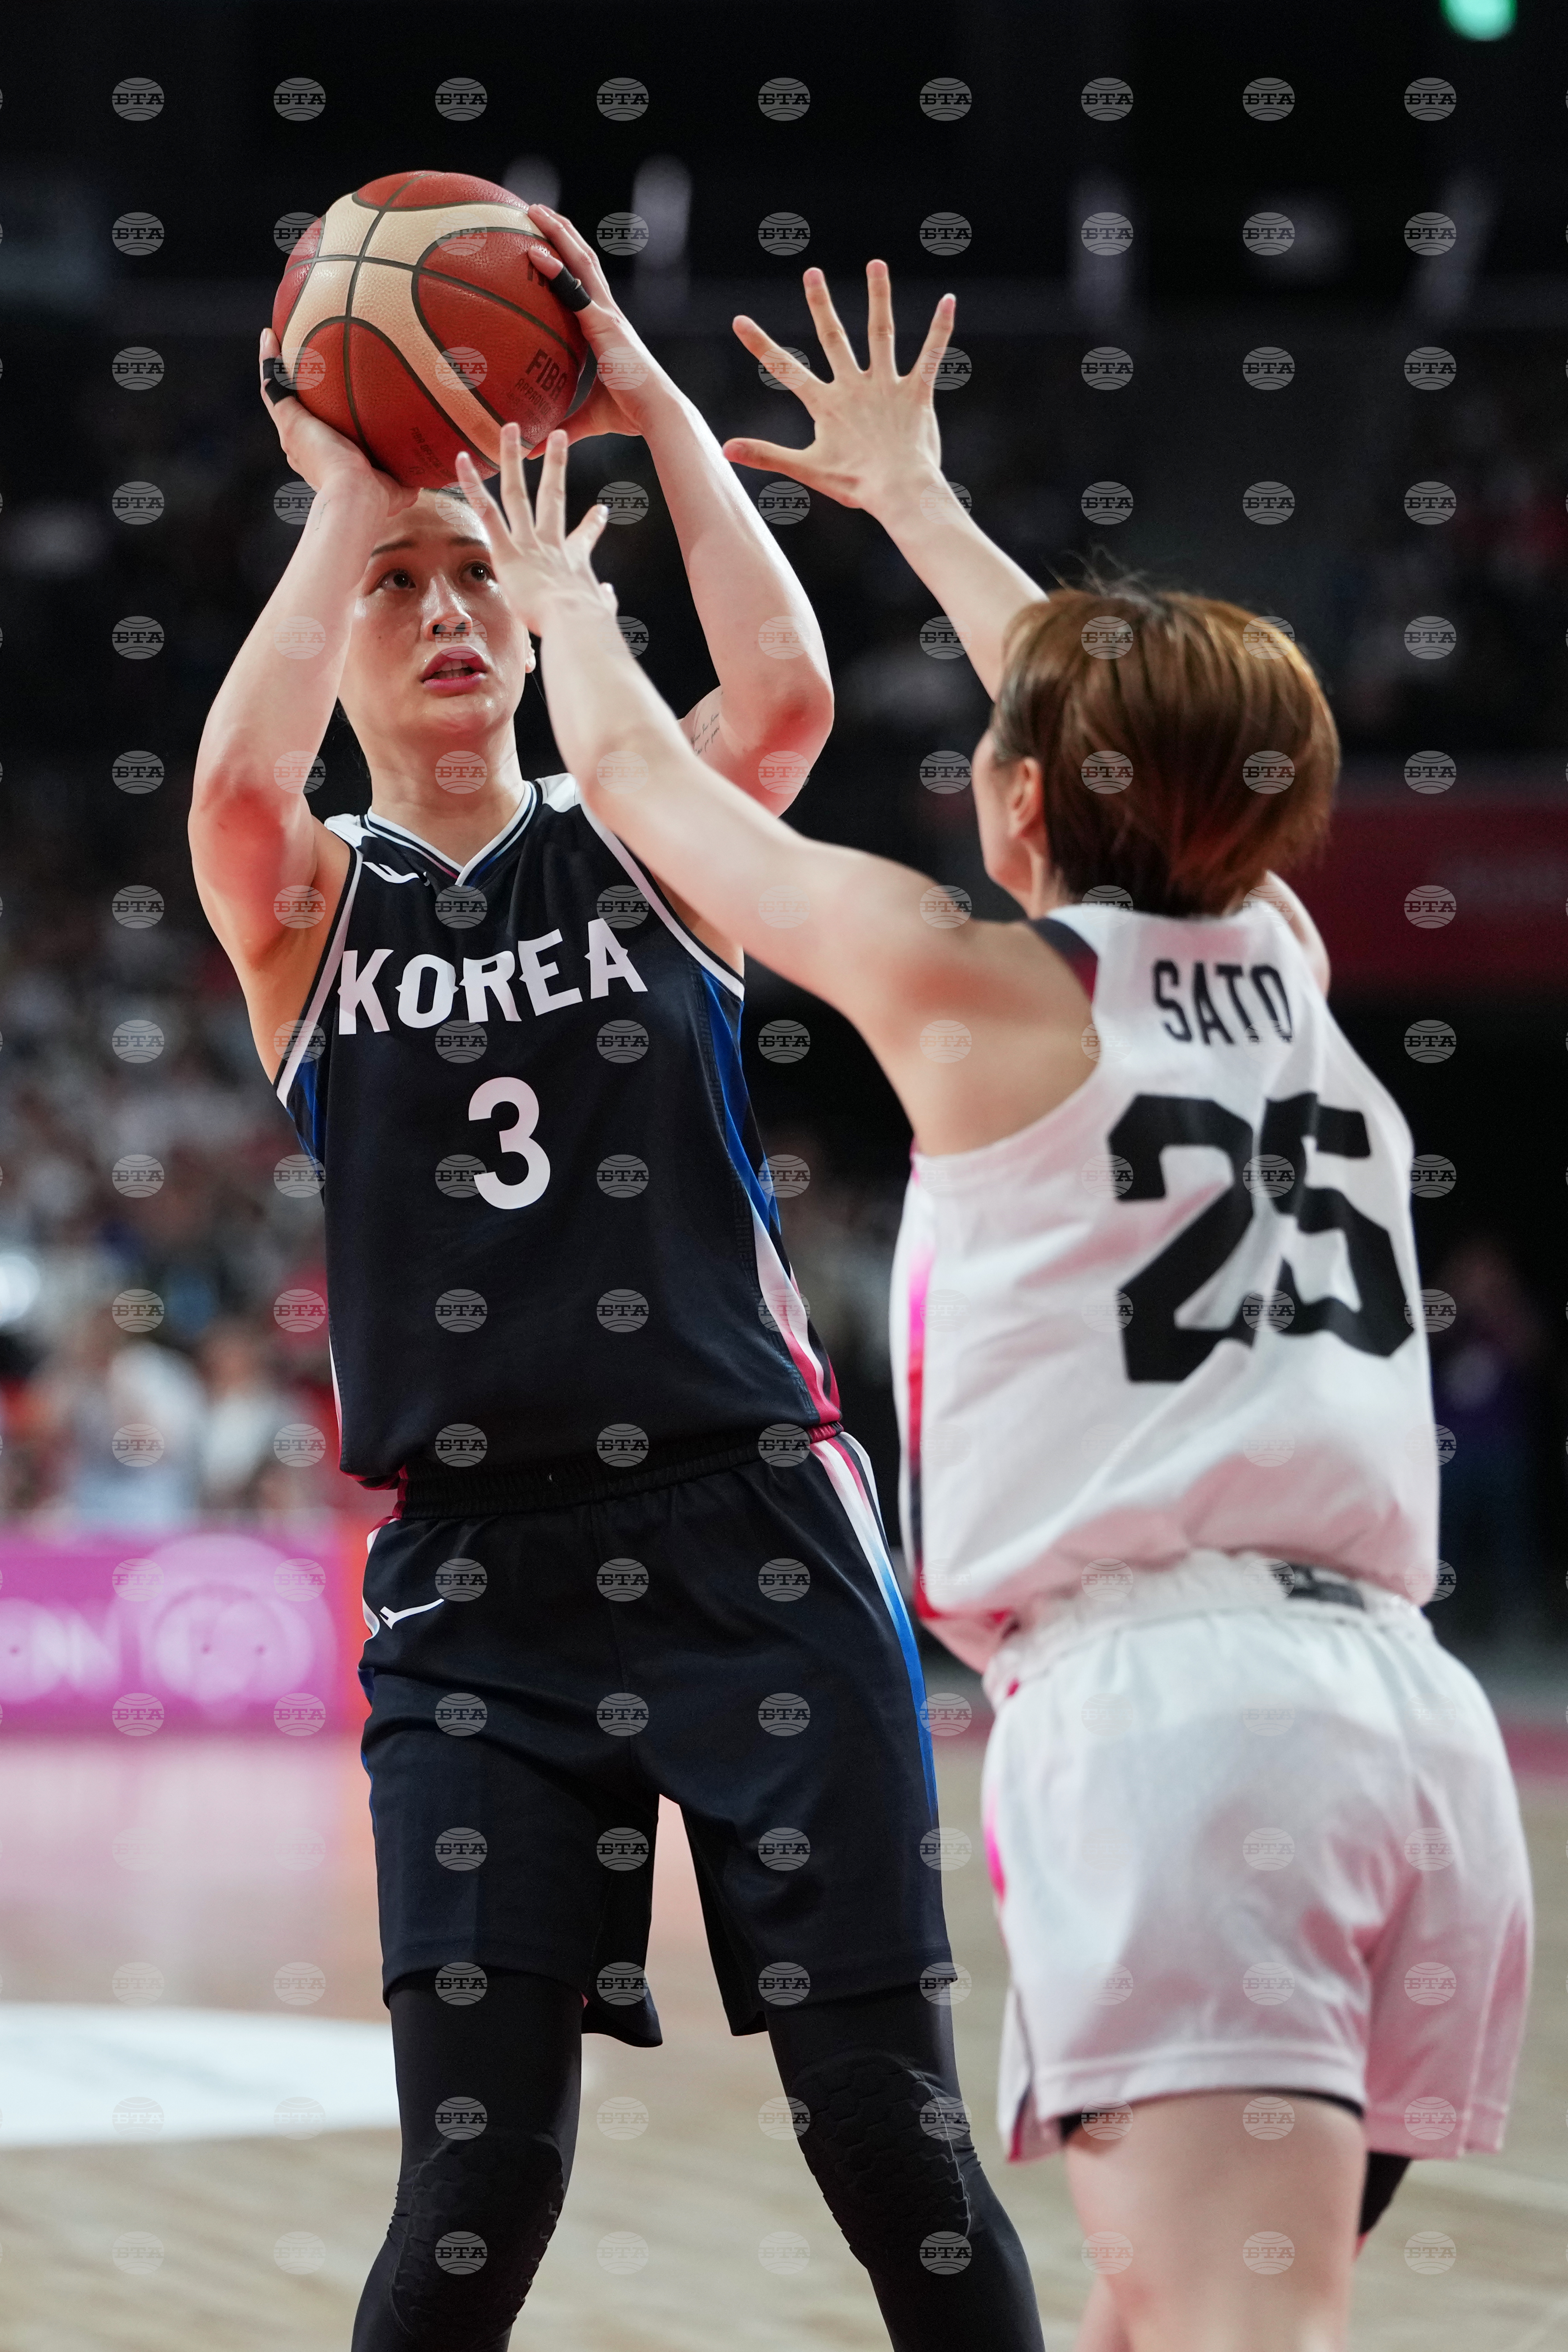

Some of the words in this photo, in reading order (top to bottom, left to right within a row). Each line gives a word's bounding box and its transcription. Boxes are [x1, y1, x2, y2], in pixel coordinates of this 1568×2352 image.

[525, 348, 568, 402] FIBA
[337, 918, 648, 1035] KOREA
[1152, 959, 1294, 1046] SATO
[468, 1076, 550, 1210] 3
[1108, 1092, 1415, 1383] 25
